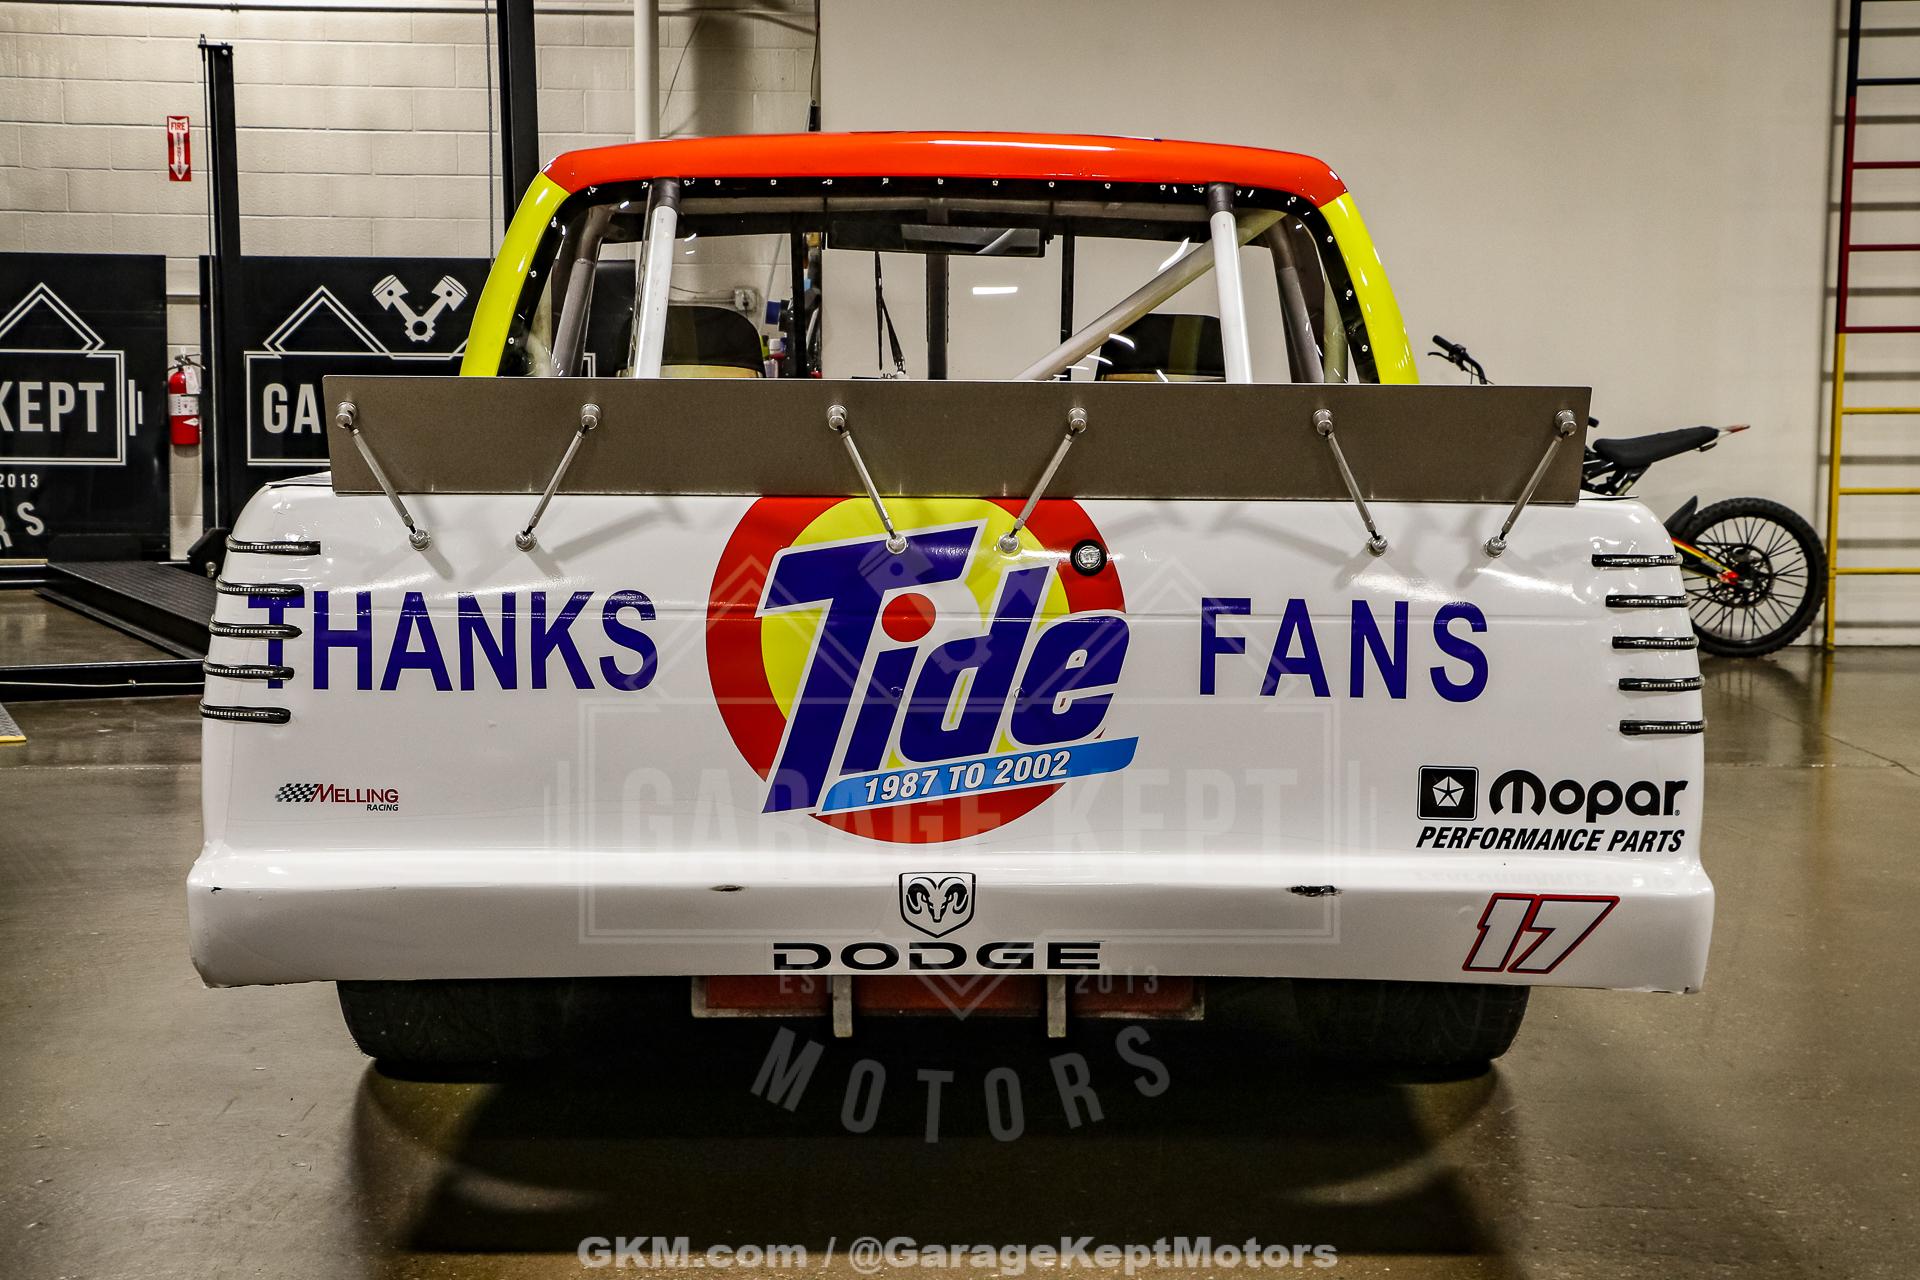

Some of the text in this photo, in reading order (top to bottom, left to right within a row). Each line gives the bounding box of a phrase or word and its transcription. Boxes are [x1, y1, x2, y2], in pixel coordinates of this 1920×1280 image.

[171, 122, 186, 130] FIRE
[247, 590, 658, 692] THANKS
[1199, 597, 1489, 702] FANS
[761, 525, 1130, 814] Tide
[310, 783, 399, 803] MELLING
[865, 750, 1072, 803] 1987 TO 2002
[366, 804, 399, 812] RACING
[1416, 826, 1685, 852] PERFORMANCE PARTS
[1462, 893, 1620, 974] 17
[773, 942, 1101, 970] DODGE
